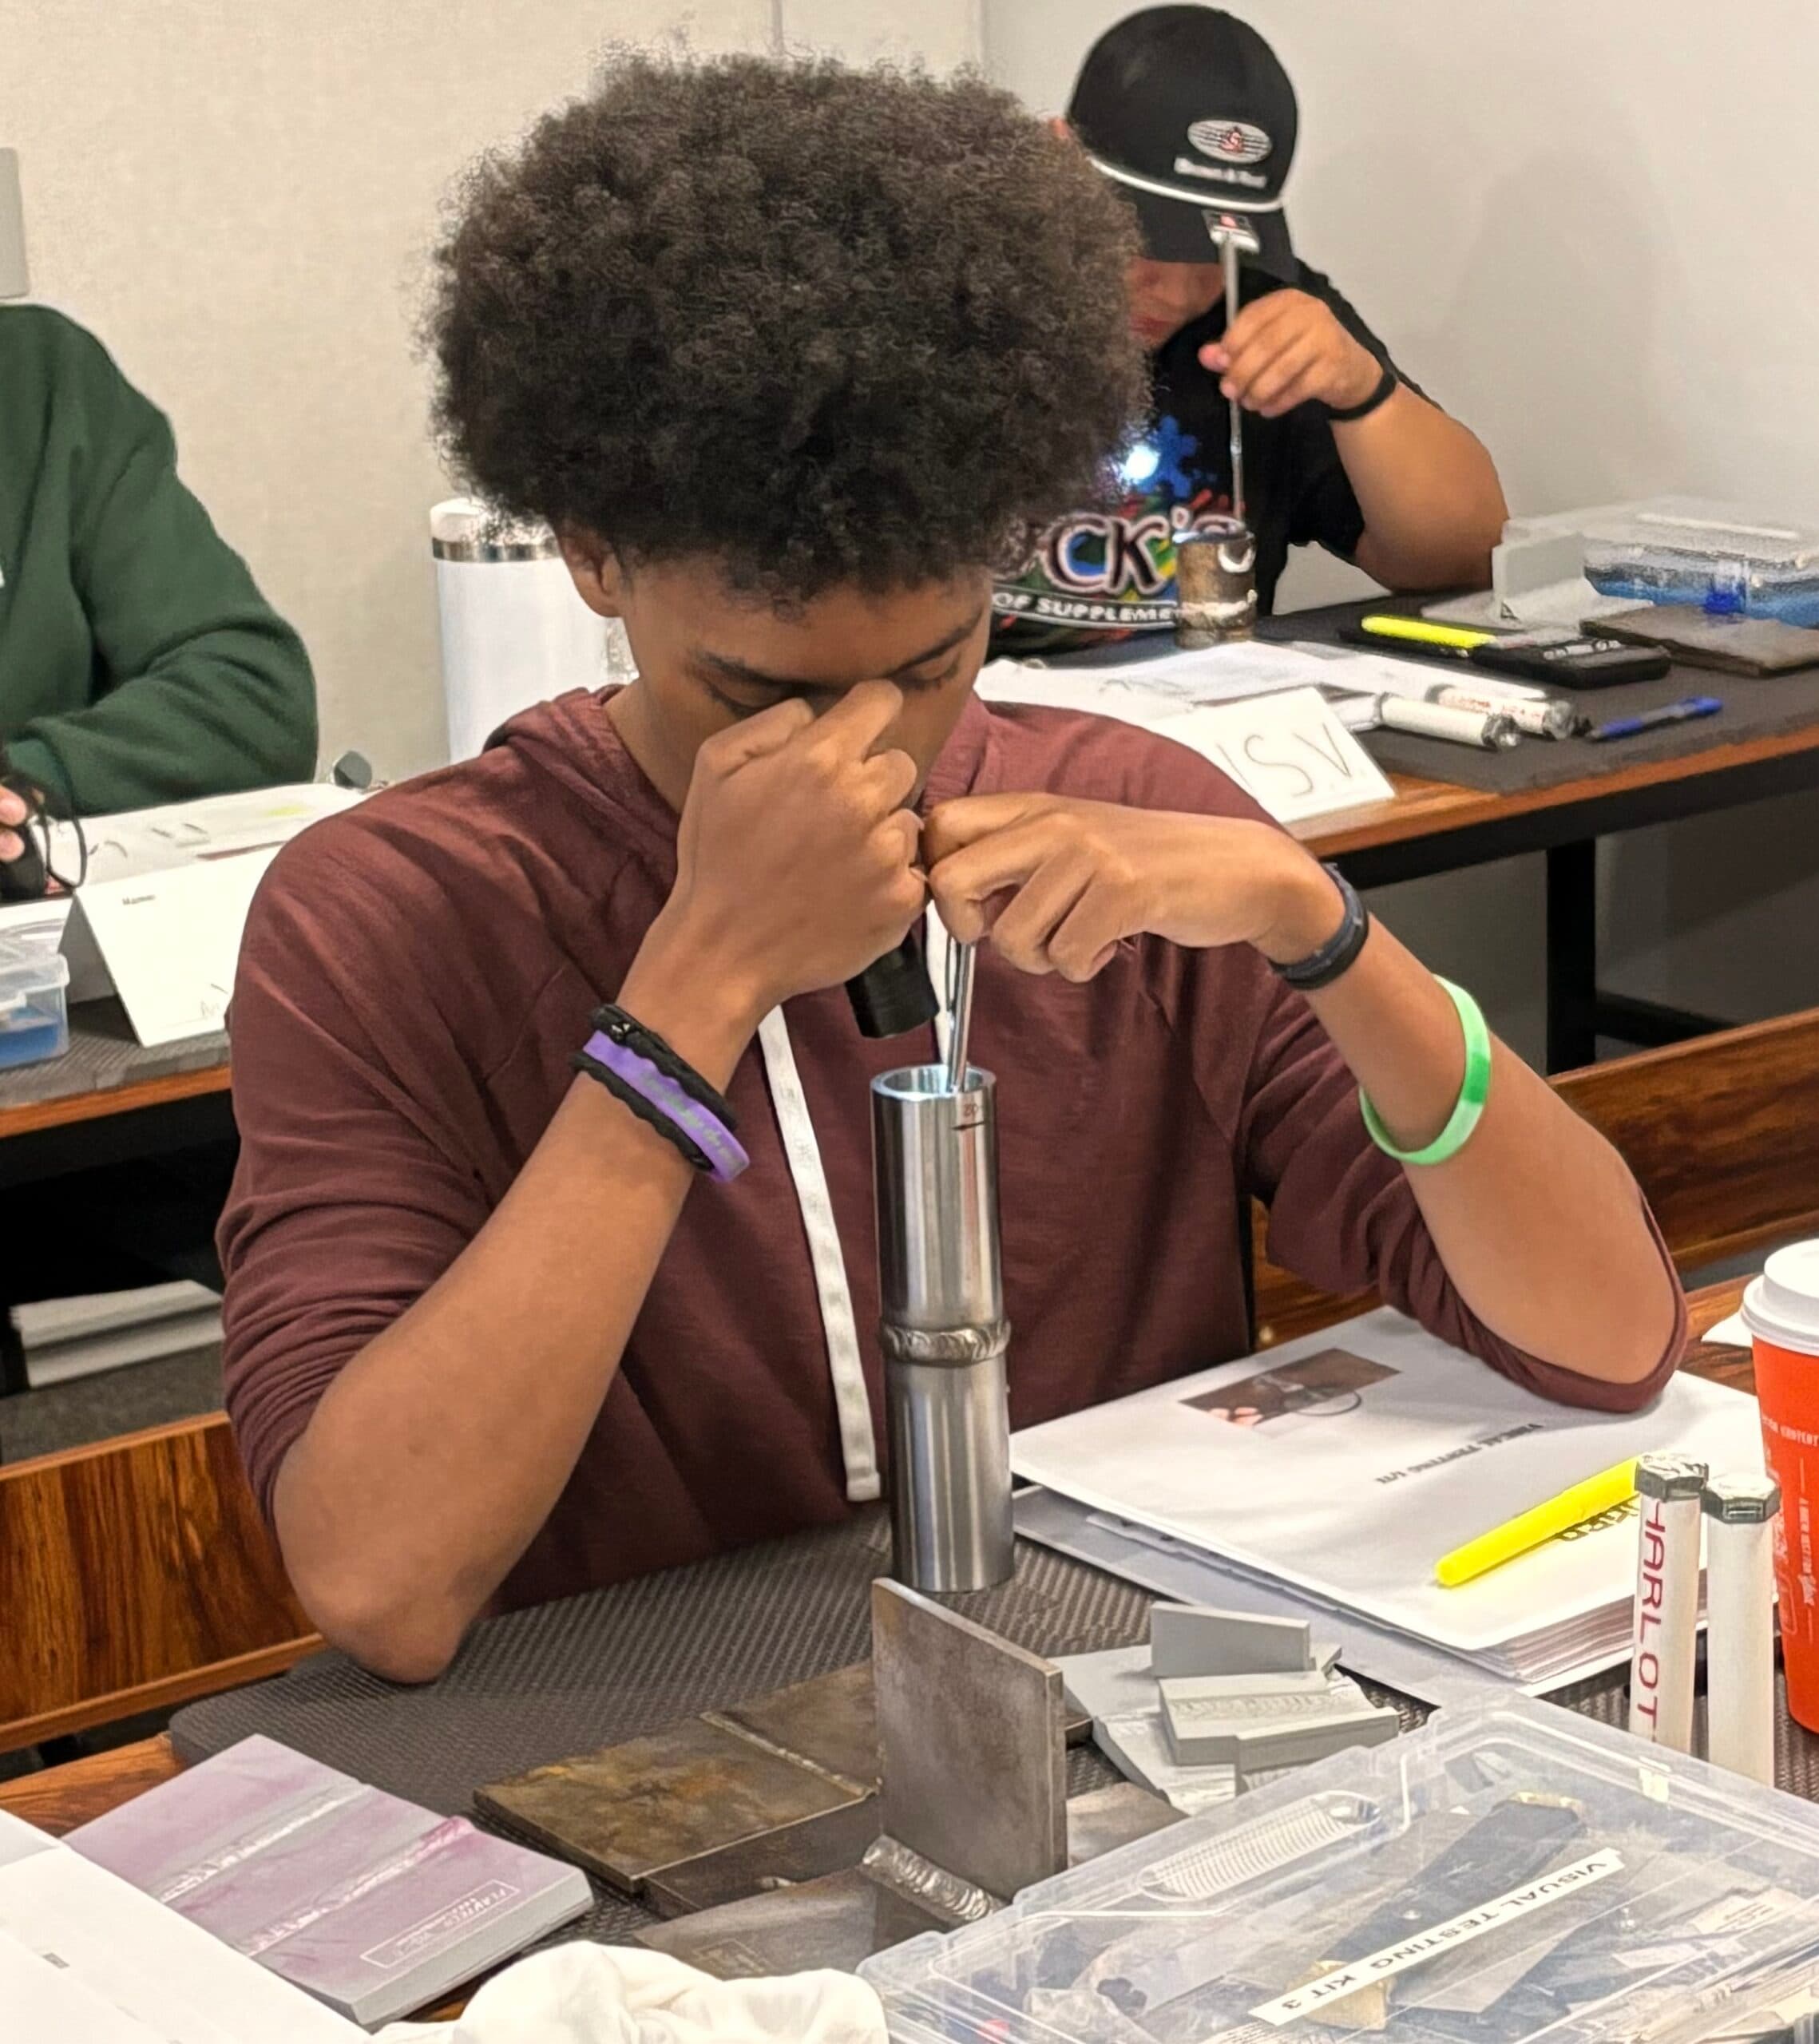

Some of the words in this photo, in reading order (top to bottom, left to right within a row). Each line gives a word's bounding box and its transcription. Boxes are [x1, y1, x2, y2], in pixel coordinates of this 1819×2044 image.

[1041, 506, 1246, 593] CK'
[993, 592, 1032, 612] OF
[1036, 597, 1188, 624] SUPPLEME
[1636, 1501, 1666, 1741] HARLOT
[1499, 1862, 1608, 1907] VISUAL
[1369, 1911, 1502, 1968] TESTING
[1281, 2000, 1302, 2010] 3
[1309, 1975, 1357, 1999] KIT
